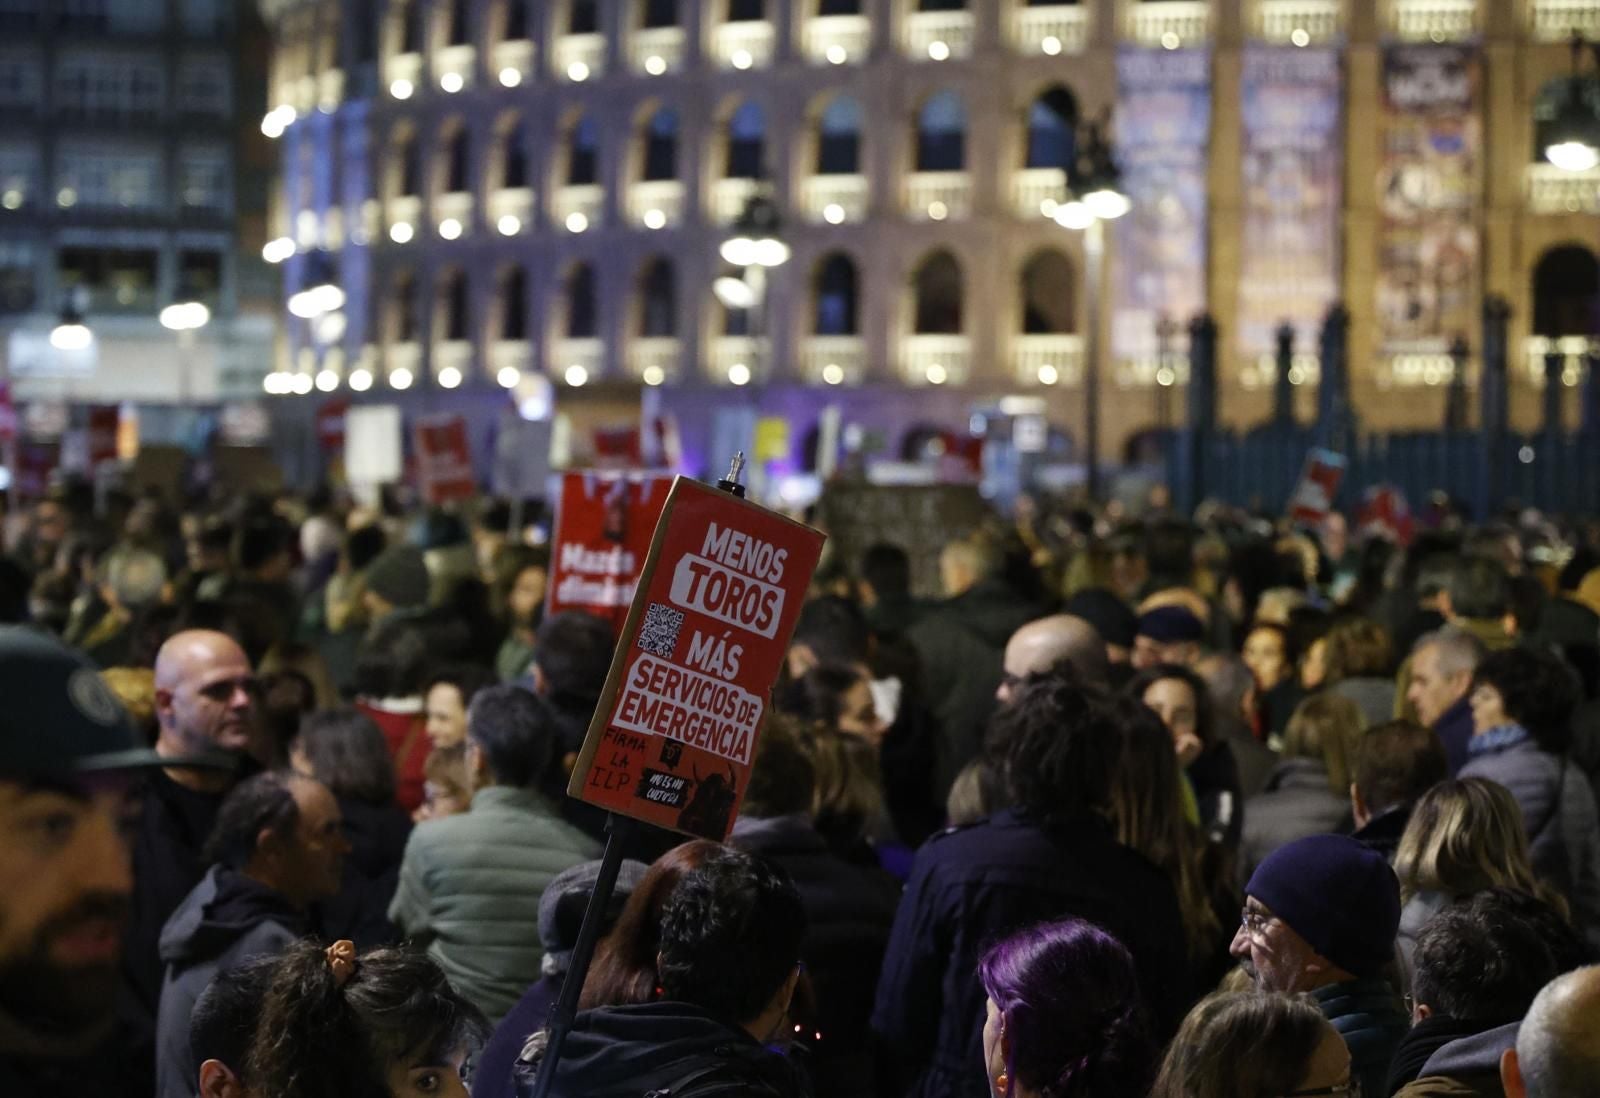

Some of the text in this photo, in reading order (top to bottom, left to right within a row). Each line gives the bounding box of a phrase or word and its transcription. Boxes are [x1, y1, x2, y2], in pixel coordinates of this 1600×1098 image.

[701, 521, 788, 584] MENOS
[688, 560, 778, 632] TOROS
[685, 631, 743, 680] MÁS
[633, 659, 758, 727] SERVICIOS DE
[603, 727, 647, 752] FIRMA
[618, 690, 749, 762] EMERGENCIA
[590, 766, 631, 791] ILP
[610, 752, 629, 768] LA
